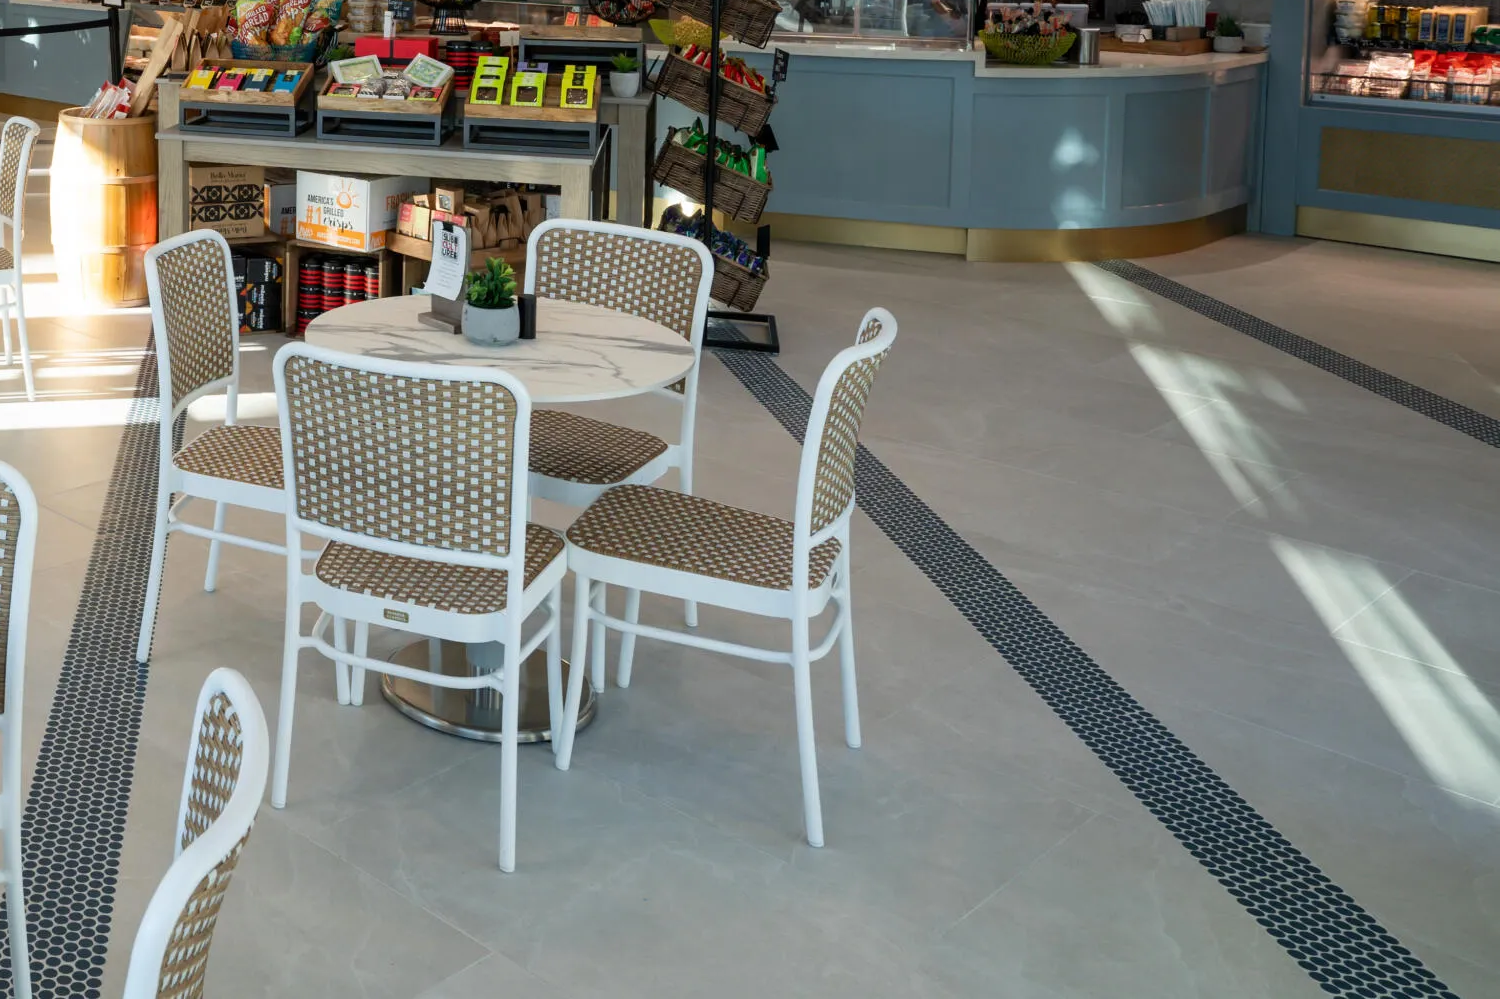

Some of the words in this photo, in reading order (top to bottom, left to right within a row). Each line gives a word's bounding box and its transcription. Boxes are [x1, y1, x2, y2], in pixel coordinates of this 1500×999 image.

[307, 194, 334, 206] AMERICA'S
[306, 205, 322, 226] #1
[323, 206, 344, 217] GRILLED
[323, 217, 353, 233] crisps
